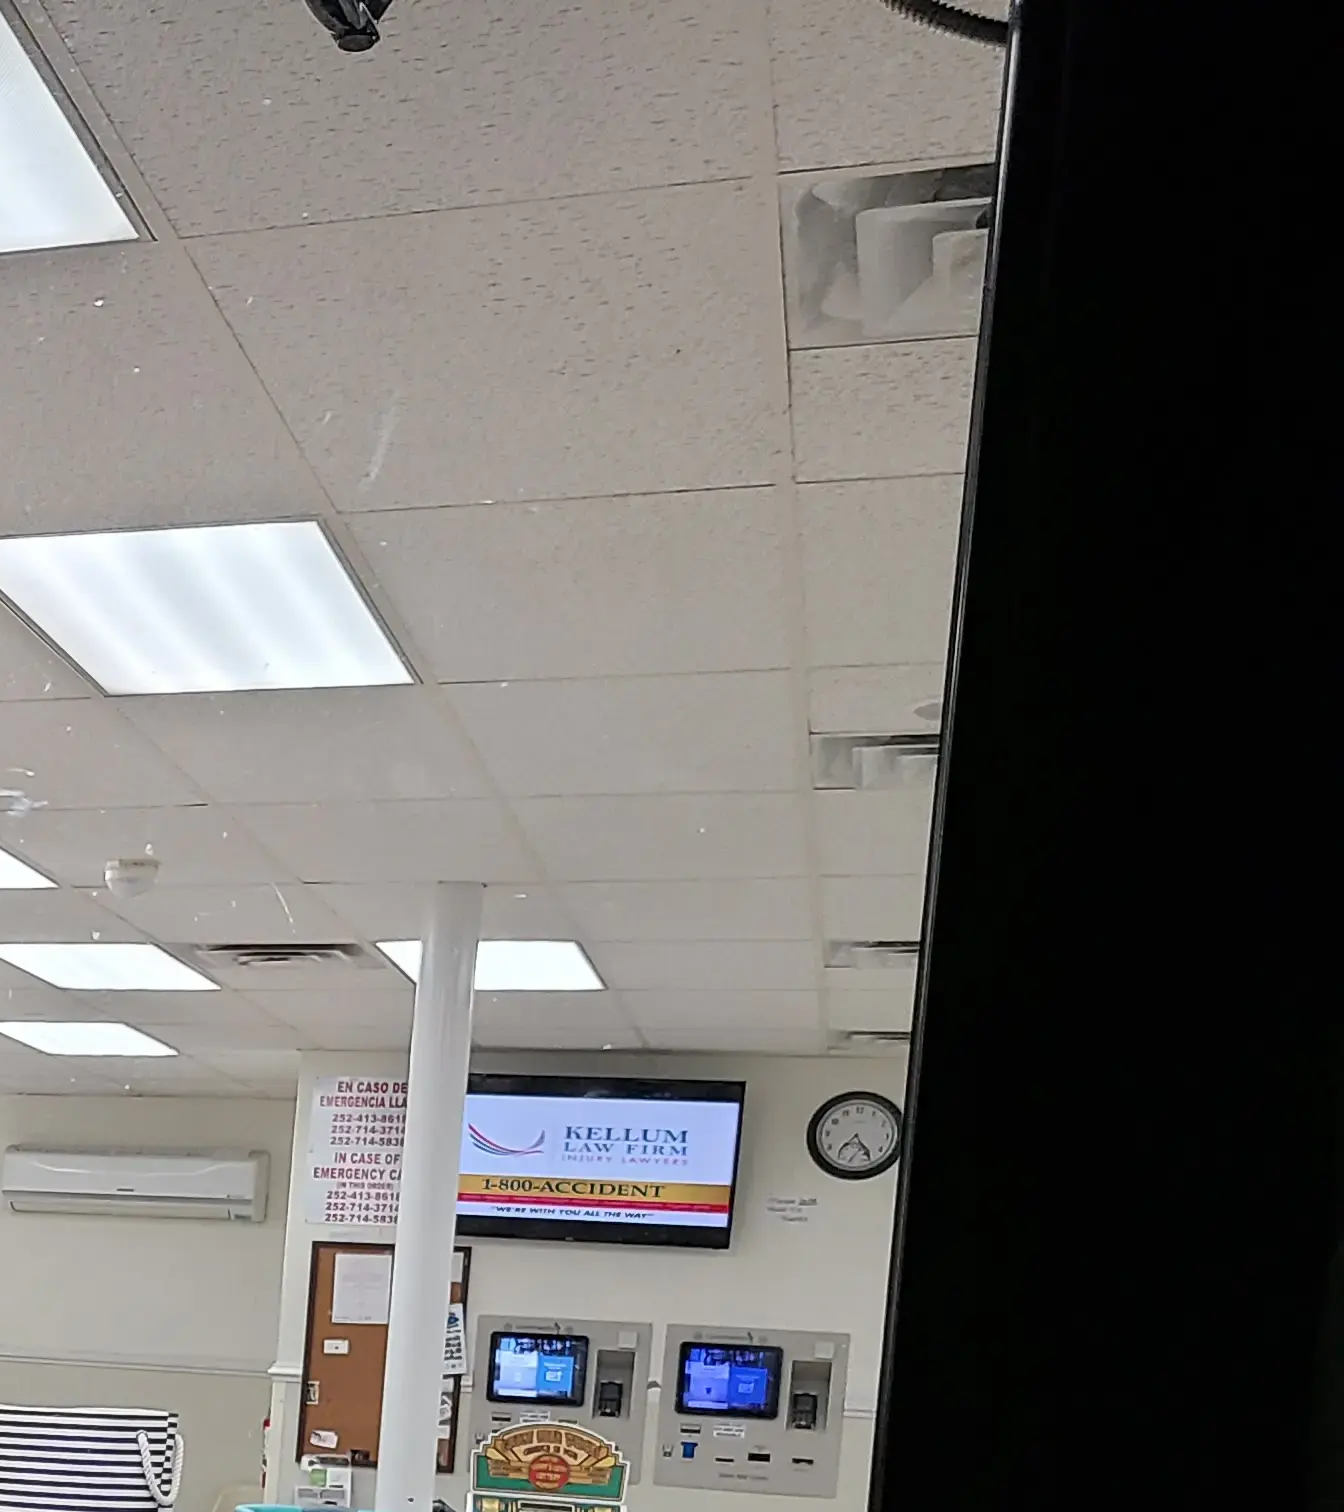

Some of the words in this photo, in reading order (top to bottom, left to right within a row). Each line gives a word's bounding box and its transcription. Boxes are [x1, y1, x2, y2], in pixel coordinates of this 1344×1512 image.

[337, 1081, 353, 1093] EN
[357, 1082, 389, 1094] CASO
[320, 1096, 386, 1108] EMERGENCIA
[564, 1126, 688, 1144] KELLUM
[564, 1142, 613, 1153] LAW
[626, 1143, 688, 1157] FIRM
[334, 1152, 346, 1164] IN
[350, 1153, 381, 1165] CASE
[384, 1154, 401, 1165] OF
[562, 1155, 612, 1163] INJURY
[621, 1156, 688, 1165] LAWYERS
[313, 1167, 386, 1180] EMERGENCY
[481, 1178, 666, 1198] 1-800-ACCIDENT
